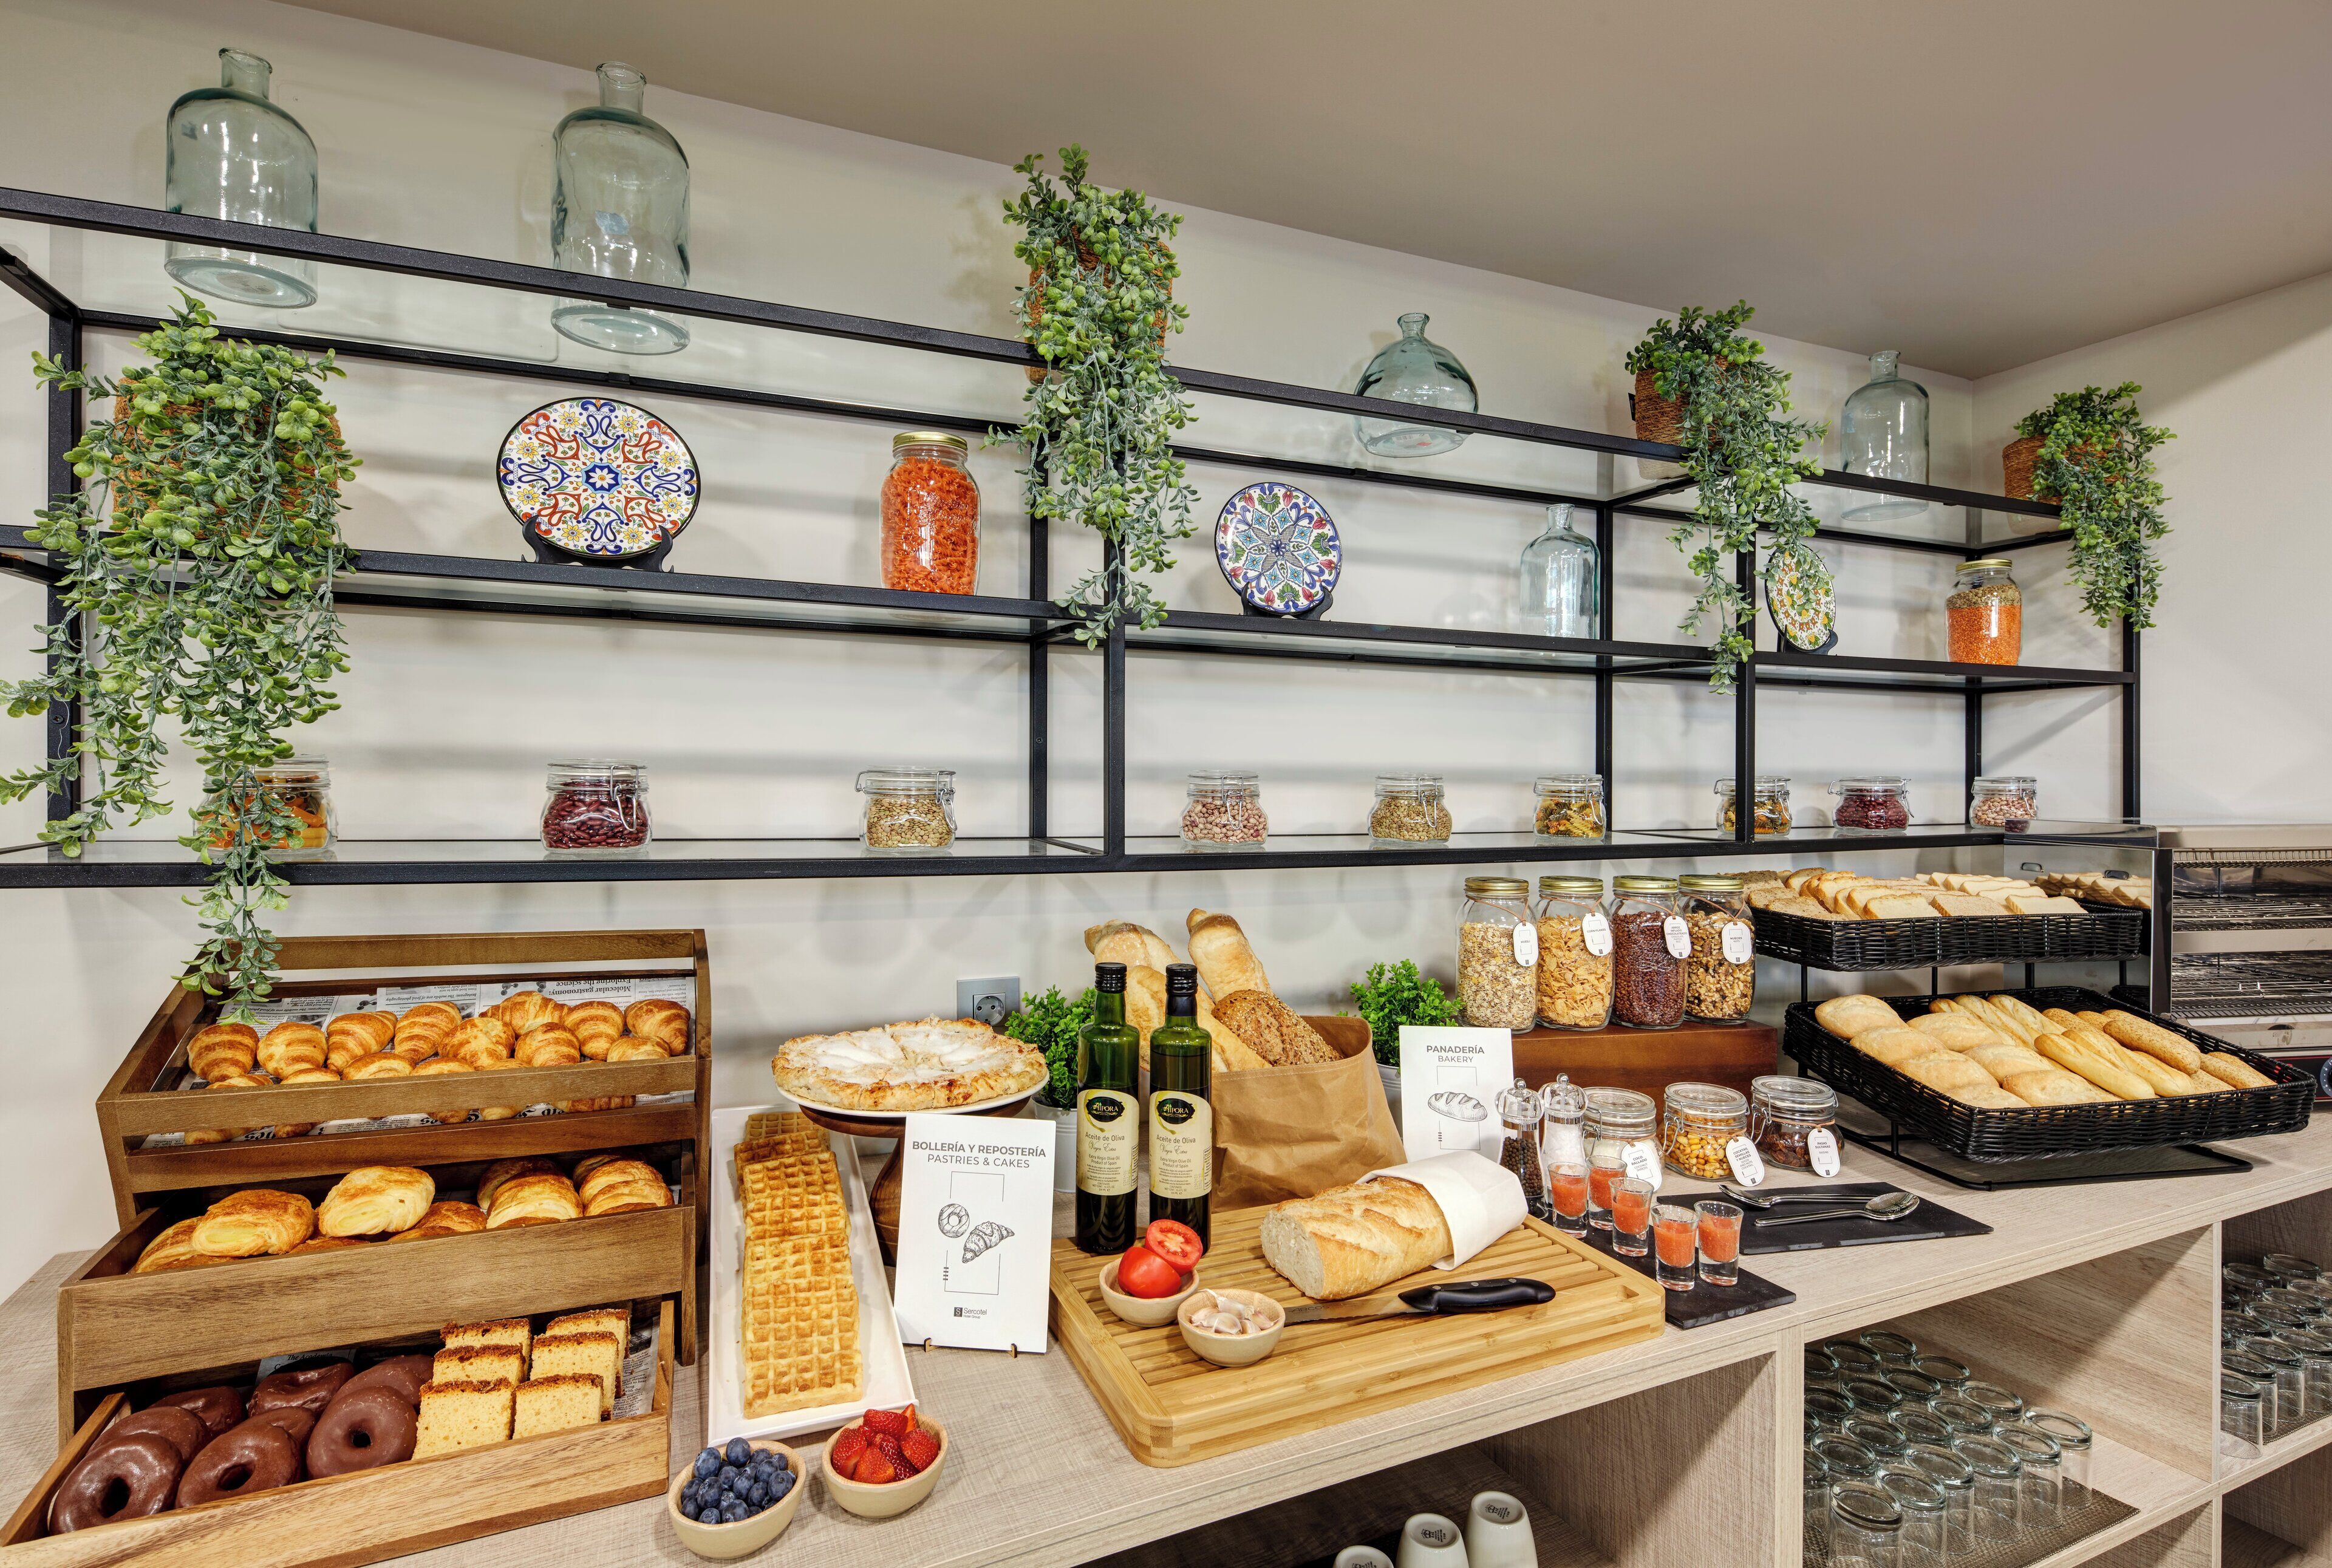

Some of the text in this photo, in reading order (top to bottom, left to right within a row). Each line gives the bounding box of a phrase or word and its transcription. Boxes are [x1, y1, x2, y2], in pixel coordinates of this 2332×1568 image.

[548, 986, 632, 996] Molecular gastronomy:
[1427, 1045, 1485, 1054] PANADERÍA
[1085, 1132, 1101, 1140] Aceite
[1156, 1134, 1172, 1143] Aceite
[912, 1141, 1046, 1157] BOLLERÍA Y REPOSTERÍA
[1734, 1150, 1750, 1159] SEMILLAS
[927, 1154, 1030, 1168] PASTRIES & CAKES
